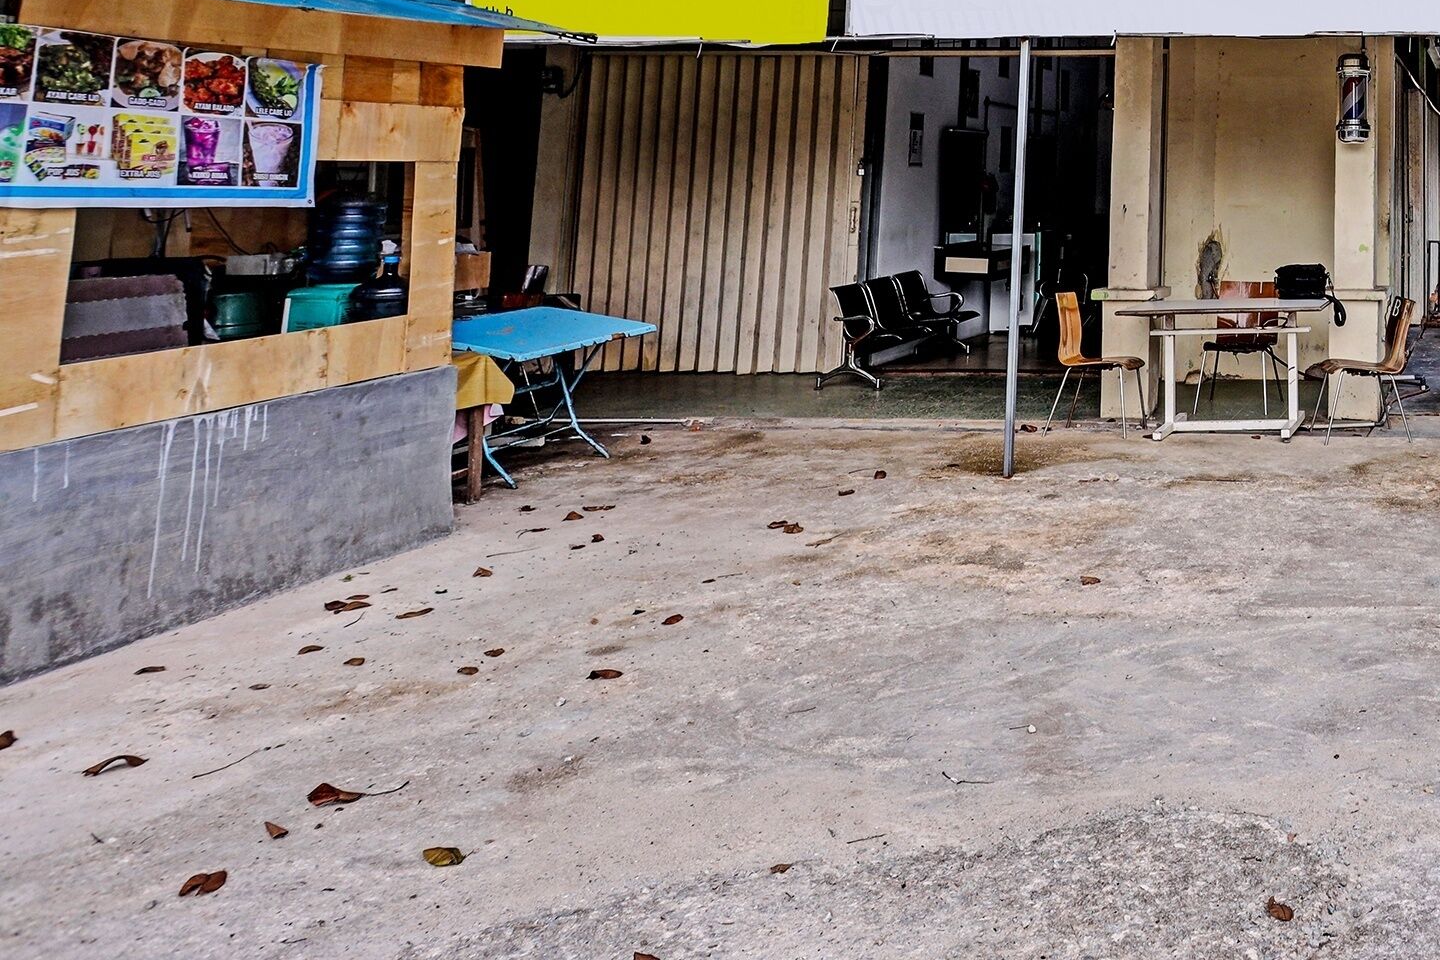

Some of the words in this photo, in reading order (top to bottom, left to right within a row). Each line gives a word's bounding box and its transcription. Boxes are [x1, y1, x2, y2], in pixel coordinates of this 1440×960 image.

[46, 91, 67, 100] AYAM
[194, 102, 212, 110] AYAM
[255, 107, 269, 115] LELE
